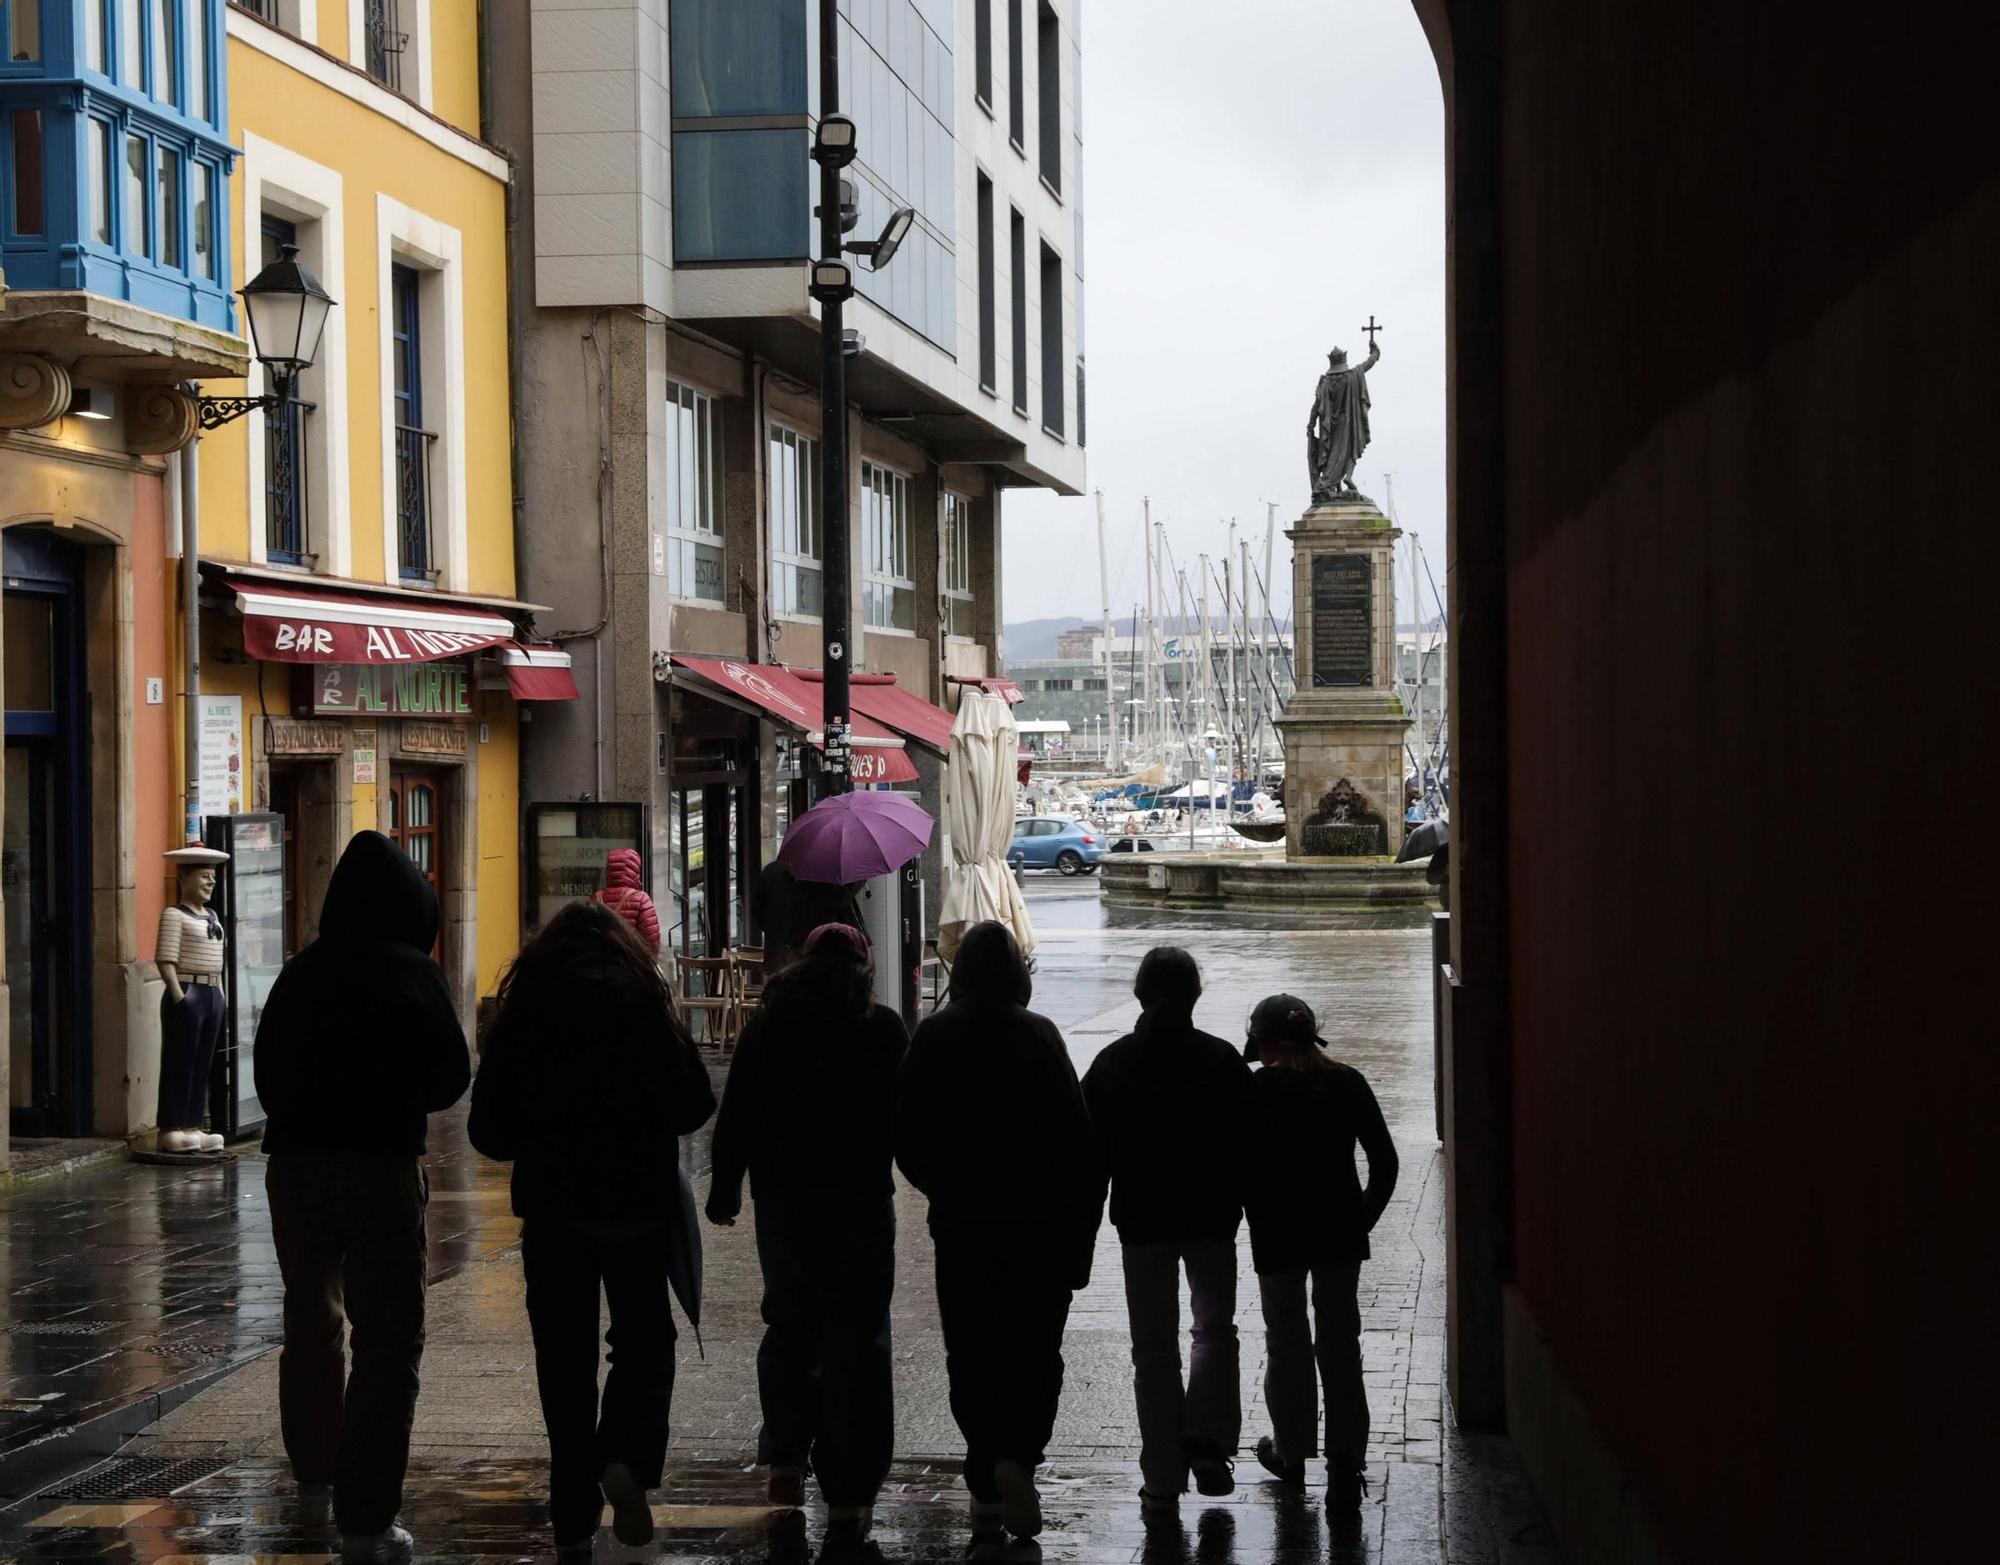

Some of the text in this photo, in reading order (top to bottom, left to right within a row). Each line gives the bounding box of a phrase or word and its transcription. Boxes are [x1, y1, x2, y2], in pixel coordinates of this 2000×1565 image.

[276, 623, 335, 654] BAR
[366, 626, 411, 659] AL
[322, 661, 471, 714] AR AL NORTE
[576, 847, 605, 860] NOR
